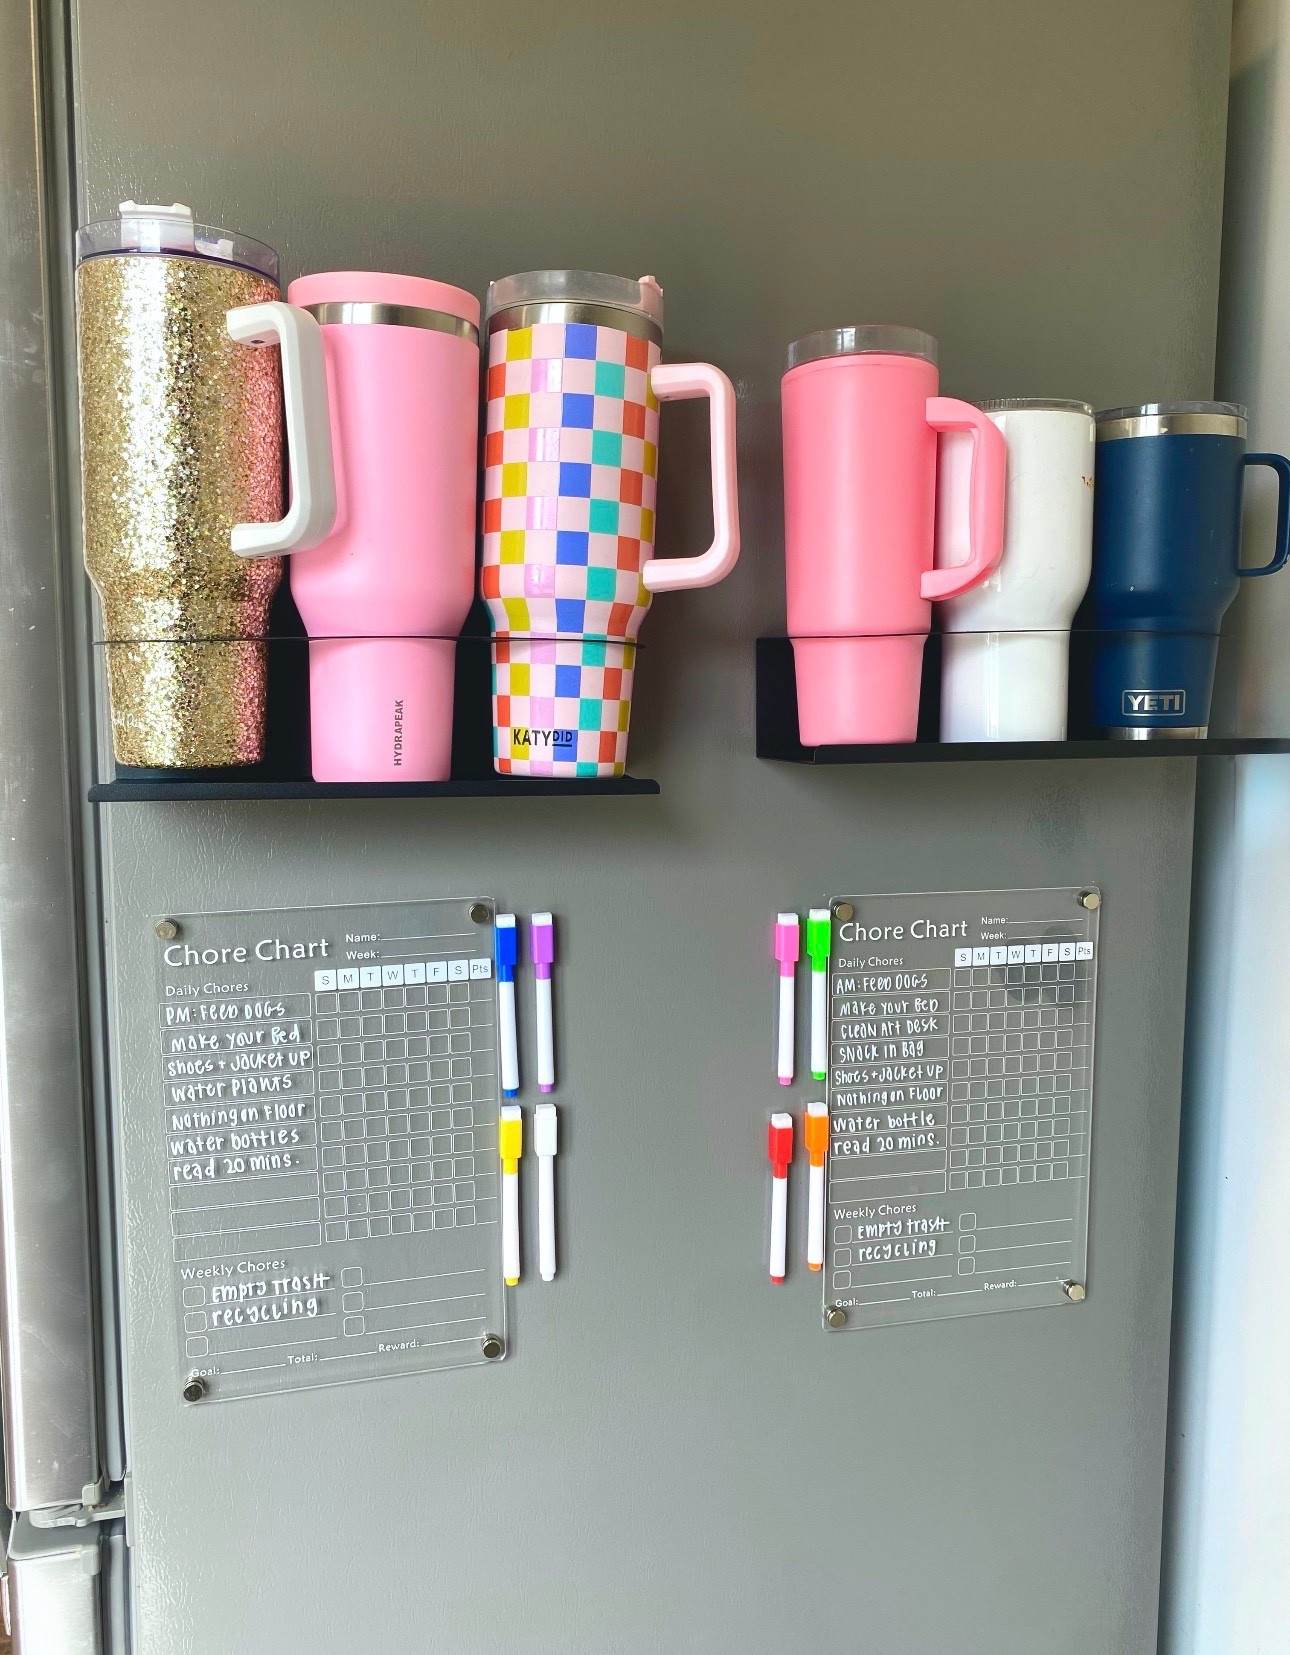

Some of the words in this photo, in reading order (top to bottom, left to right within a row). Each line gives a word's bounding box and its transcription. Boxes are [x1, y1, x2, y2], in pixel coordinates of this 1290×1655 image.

[1128, 695, 1180, 710] YETI
[394, 700, 403, 766] HYDRAPEAK
[346, 933, 380, 942] Name:
[840, 923, 904, 941] Chore
[911, 920, 968, 938] Chart
[981, 932, 1007, 940] Week:
[164, 945, 247, 967] Chore
[255, 939, 329, 961] Chart
[346, 950, 380, 960] Week:
[839, 958, 865, 968] Daily
[868, 957, 903, 966] Chores
[322, 976, 330, 985] S
[344, 974, 353, 983] M
[367, 973, 374, 981] T
[388, 971, 398, 979] W
[412, 969, 418, 978] T
[433, 968, 440, 976] F
[455, 966, 462, 974] S
[472, 964, 488, 973] Pts
[166, 985, 200, 997] Daily
[204, 983, 248, 993] Chores
[837, 978, 860, 994] AM:
[166, 1006, 196, 1025] PM:
[888, 1110, 934, 1128] bottle
[231, 1129, 299, 1150] bottles
[834, 1137, 870, 1154] read
[877, 1138, 893, 1151] 20
[173, 1158, 215, 1180] read
[223, 1158, 244, 1173] 20
[834, 1208, 875, 1219] Weekly
[879, 1205, 916, 1216] Chores
[859, 1239, 936, 1261] recycling
[181, 1264, 233, 1280] Weekly
[237, 1260, 285, 1273] Chores
[835, 1299, 859, 1307] Goal:
[912, 1290, 936, 1299] Total:
[984, 1281, 1017, 1290] Reward:
[212, 1298, 318, 1326] recycling
[288, 1354, 318, 1364] Total:
[379, 1339, 420, 1353] Reward:
